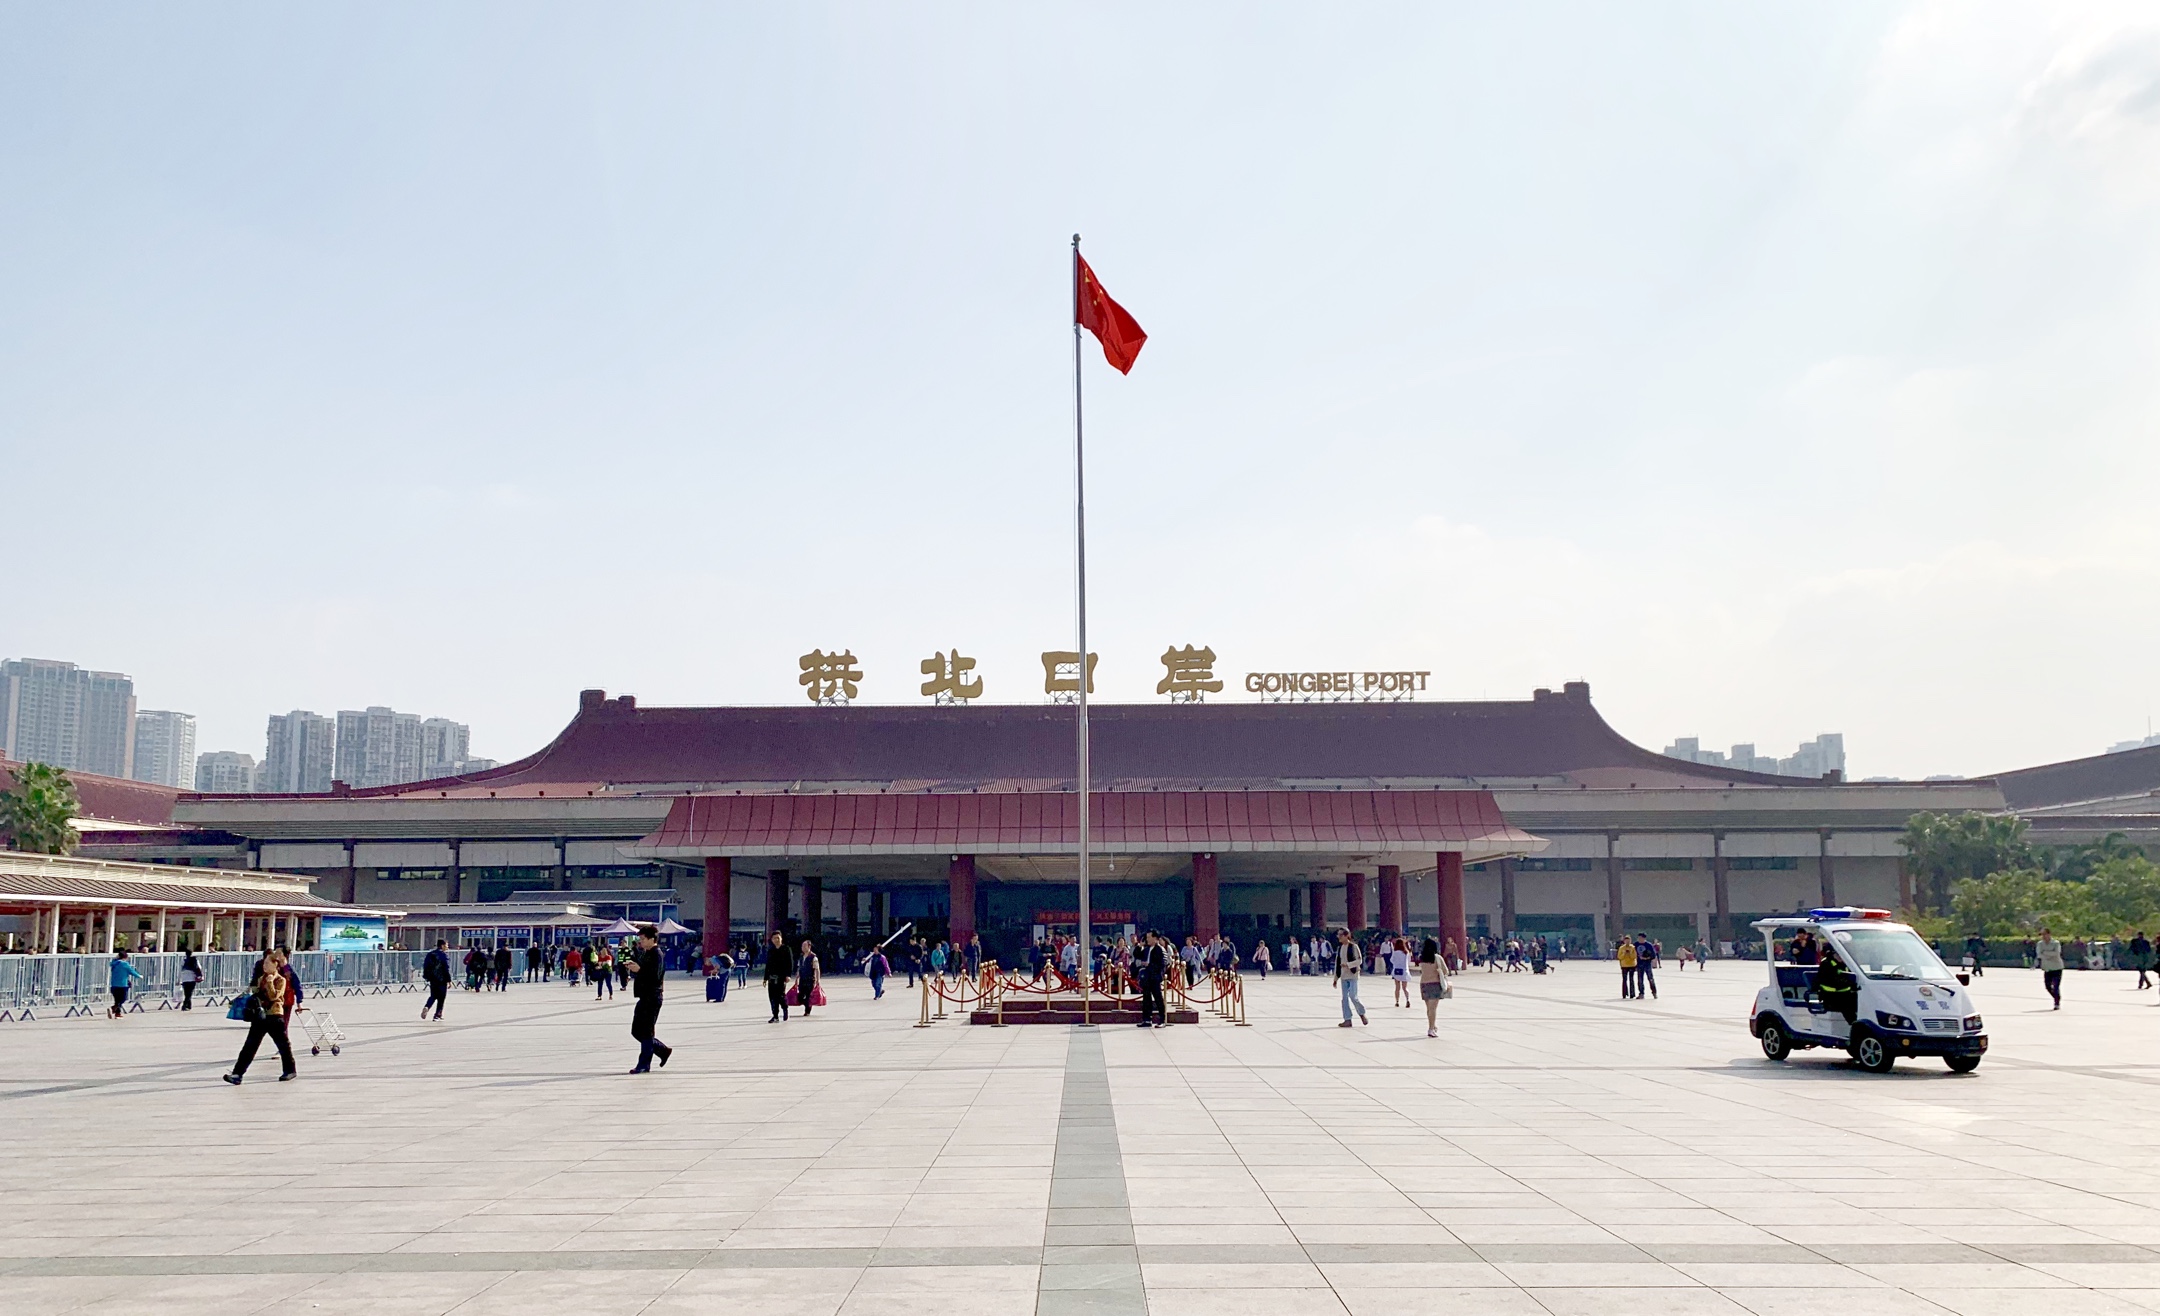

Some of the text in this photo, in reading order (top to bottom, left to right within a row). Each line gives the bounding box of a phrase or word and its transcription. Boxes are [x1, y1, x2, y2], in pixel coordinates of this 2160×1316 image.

[799, 643, 1224, 701] 拱北口岸
[1245, 671, 1431, 692] GONGBEI PORT
